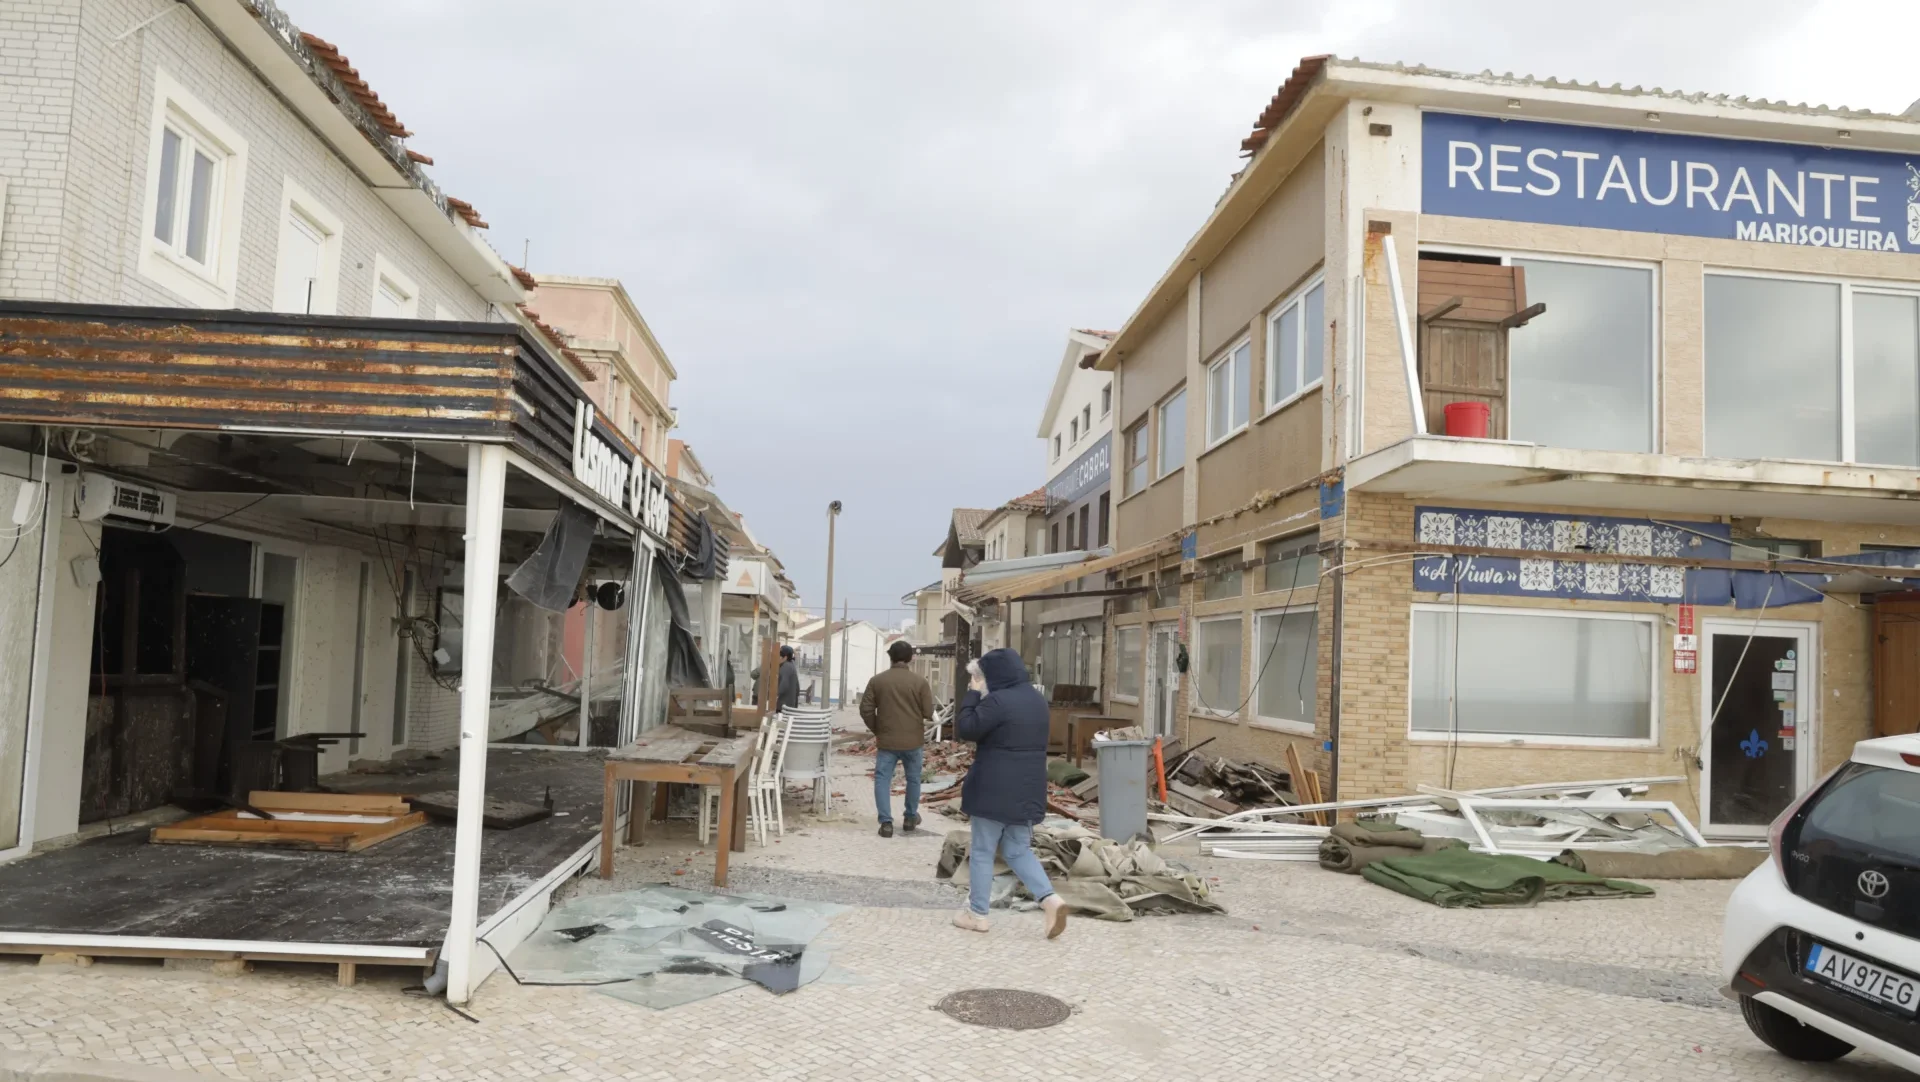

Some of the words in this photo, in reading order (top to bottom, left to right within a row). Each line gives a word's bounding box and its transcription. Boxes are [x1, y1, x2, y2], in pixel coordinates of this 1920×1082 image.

[1447, 139, 1881, 223] RESTAURANTE
[1736, 220, 1899, 251] MARISQUEIRA
[573, 399, 628, 509] Lismar
[630, 455, 643, 518] O
[1079, 445, 1109, 486] CABRAL
[1821, 954, 1914, 1005] AV97EG
